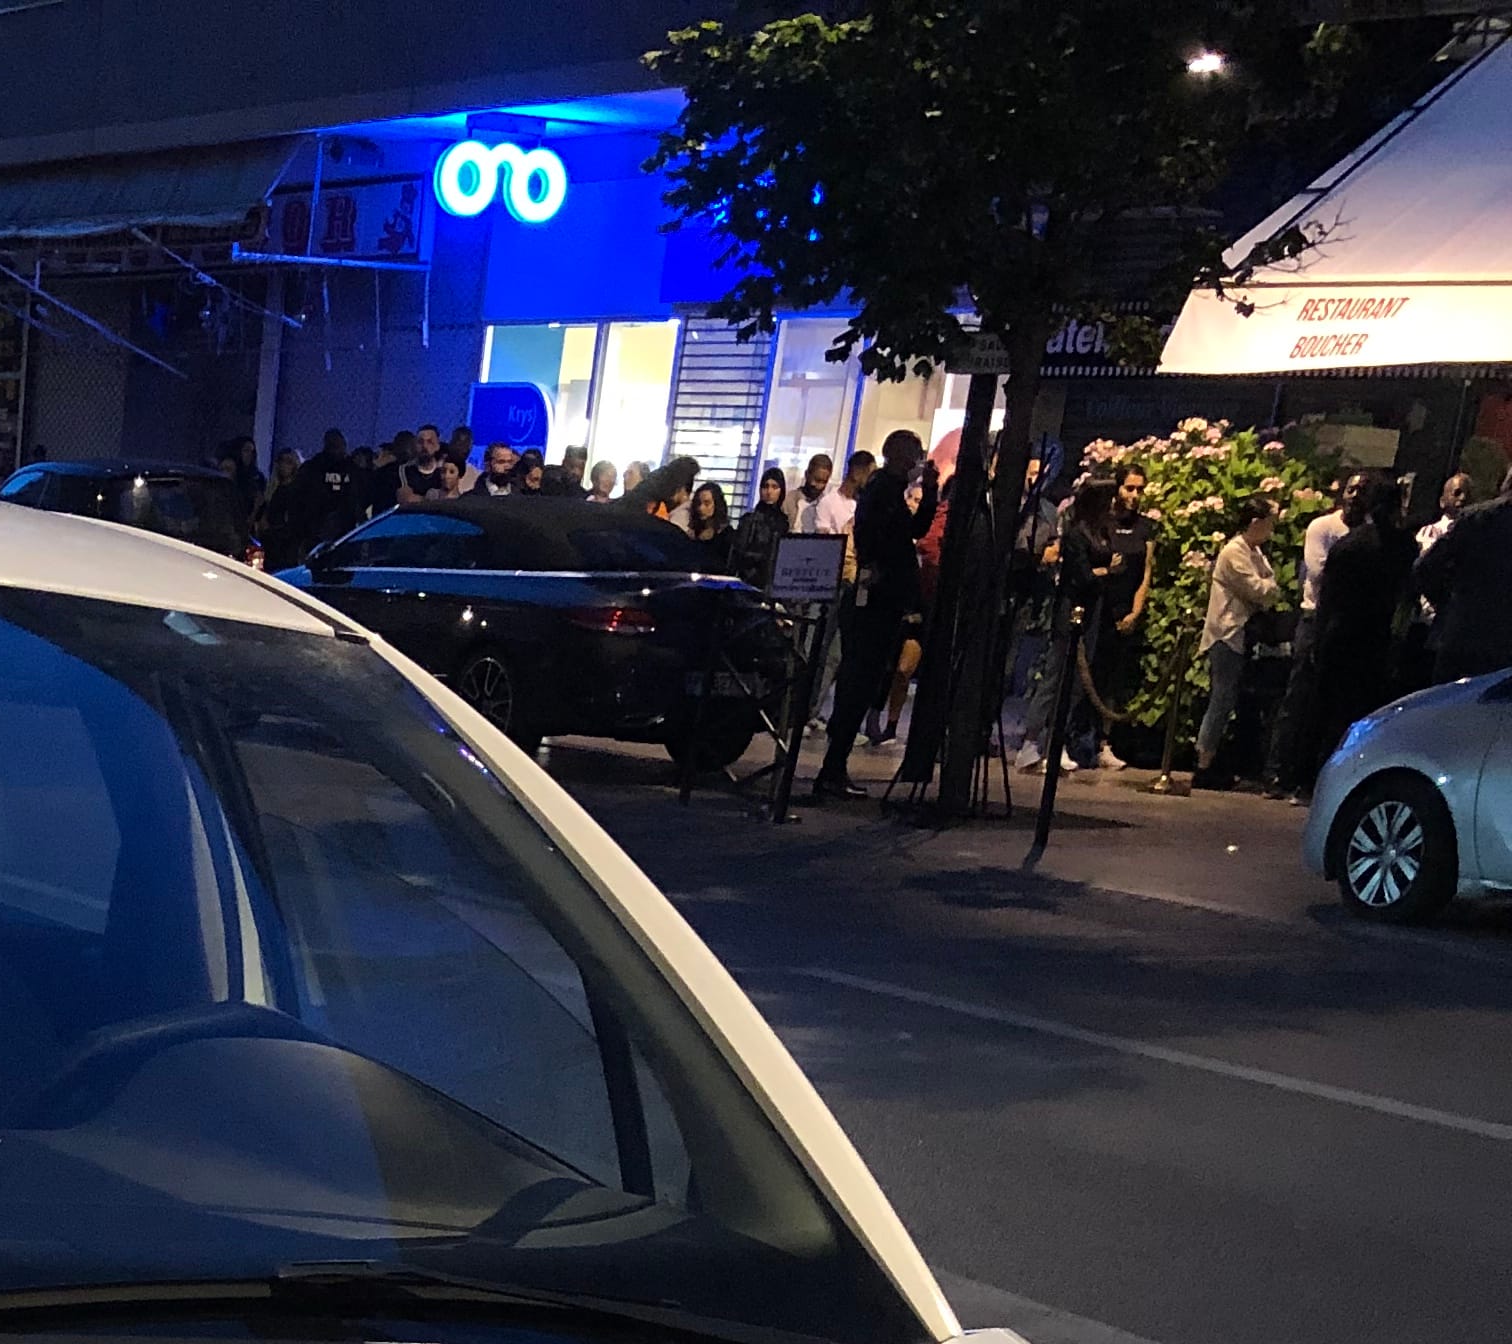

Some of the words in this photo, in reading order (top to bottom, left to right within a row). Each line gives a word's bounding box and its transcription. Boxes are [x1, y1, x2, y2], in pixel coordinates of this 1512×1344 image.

[1297, 297, 1410, 321] RESTAURANT
[1289, 333, 1369, 359] BOUCHER
[508, 405, 533, 428] Krys
